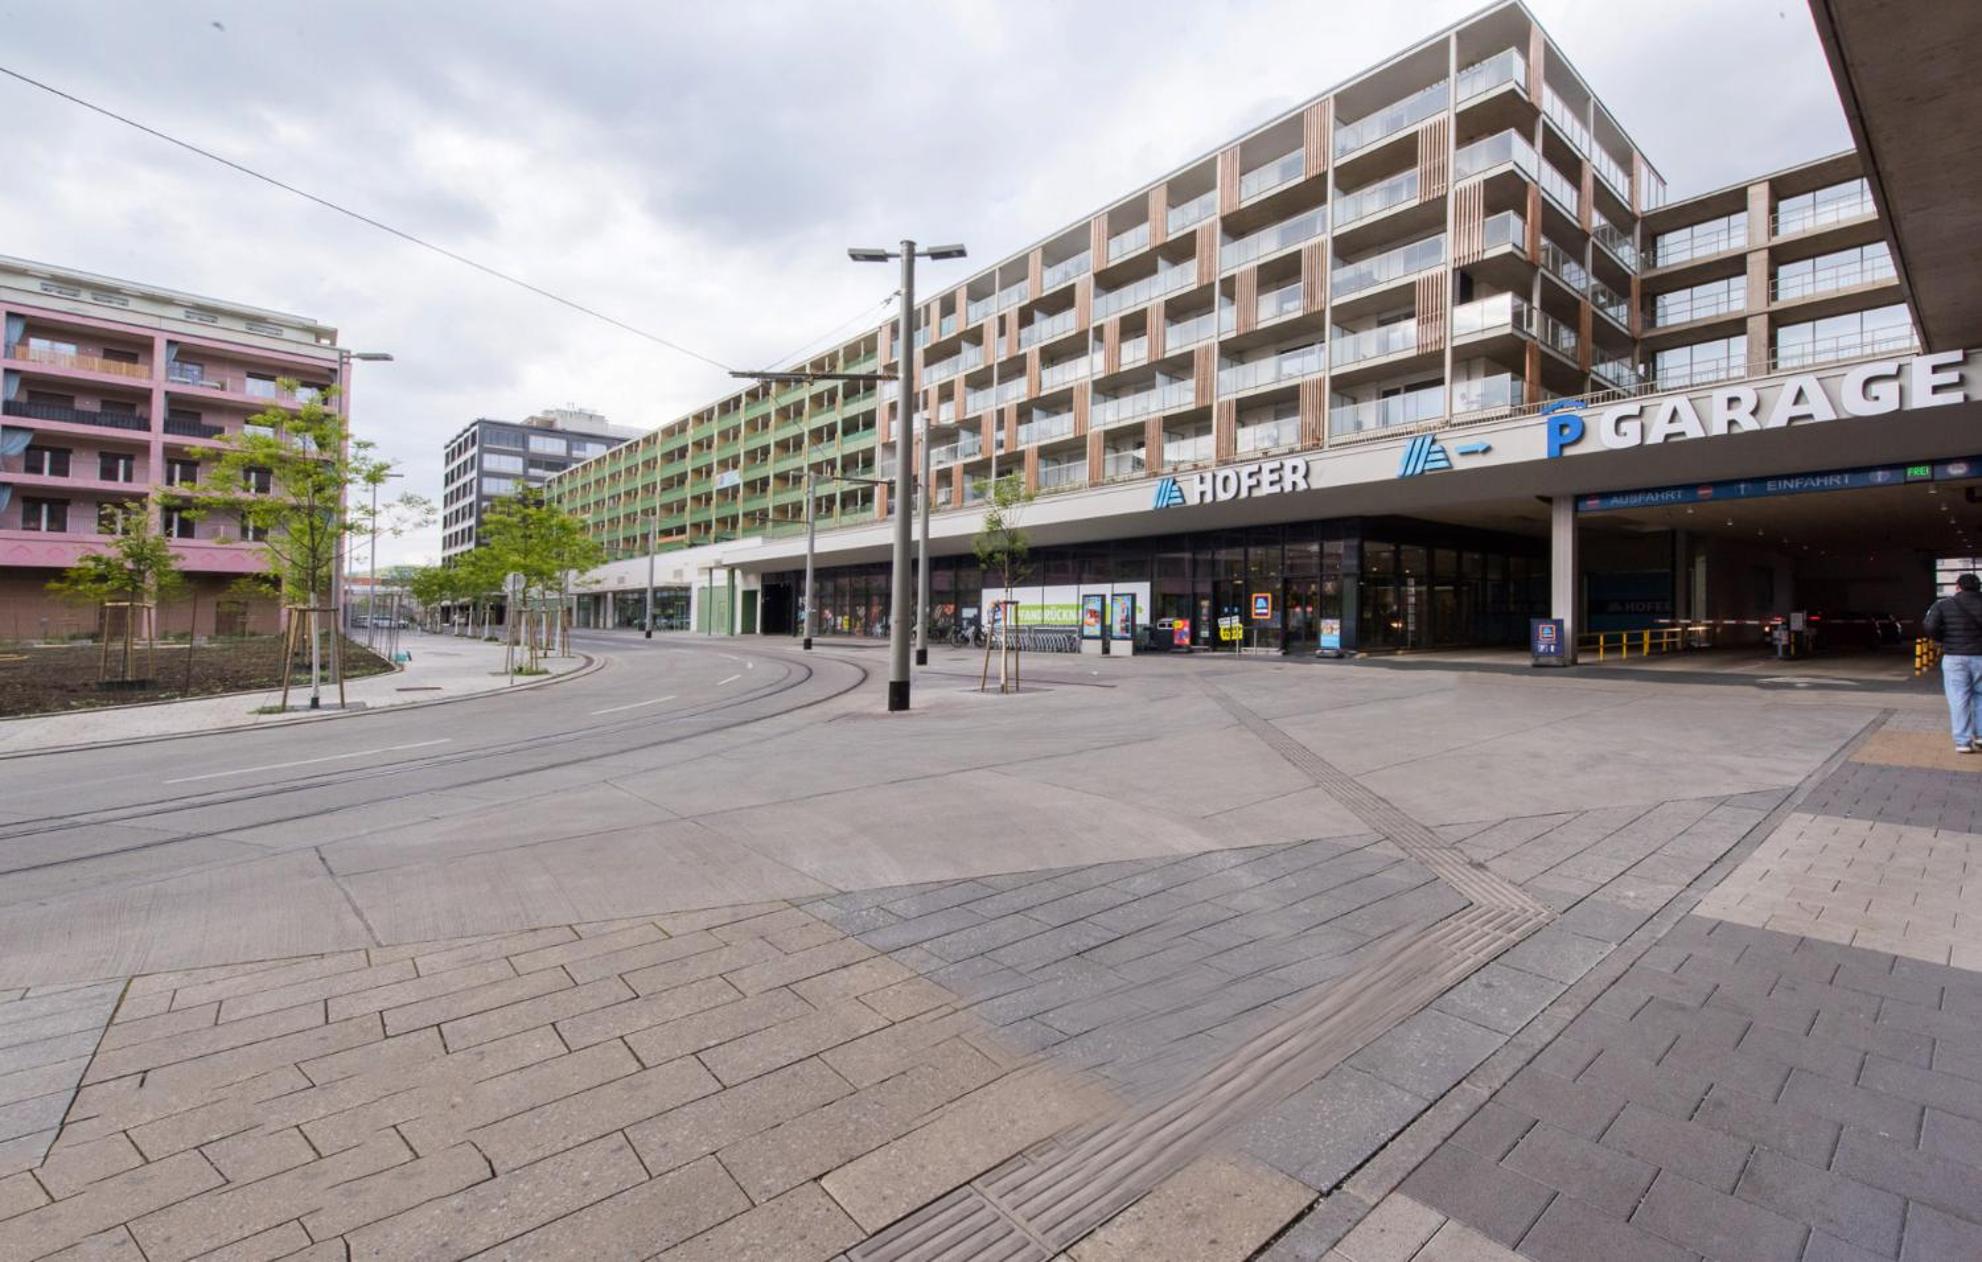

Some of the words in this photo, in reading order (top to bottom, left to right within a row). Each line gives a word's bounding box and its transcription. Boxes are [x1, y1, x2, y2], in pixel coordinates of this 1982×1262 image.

[1547, 414, 1585, 459] P
[1599, 349, 1965, 449] GARAGE
[1907, 466, 1929, 477] FREI
[1193, 458, 1310, 504] HOFER
[1766, 474, 1850, 491] EINFAHRT
[1610, 489, 1684, 505] AUSFAHRT
